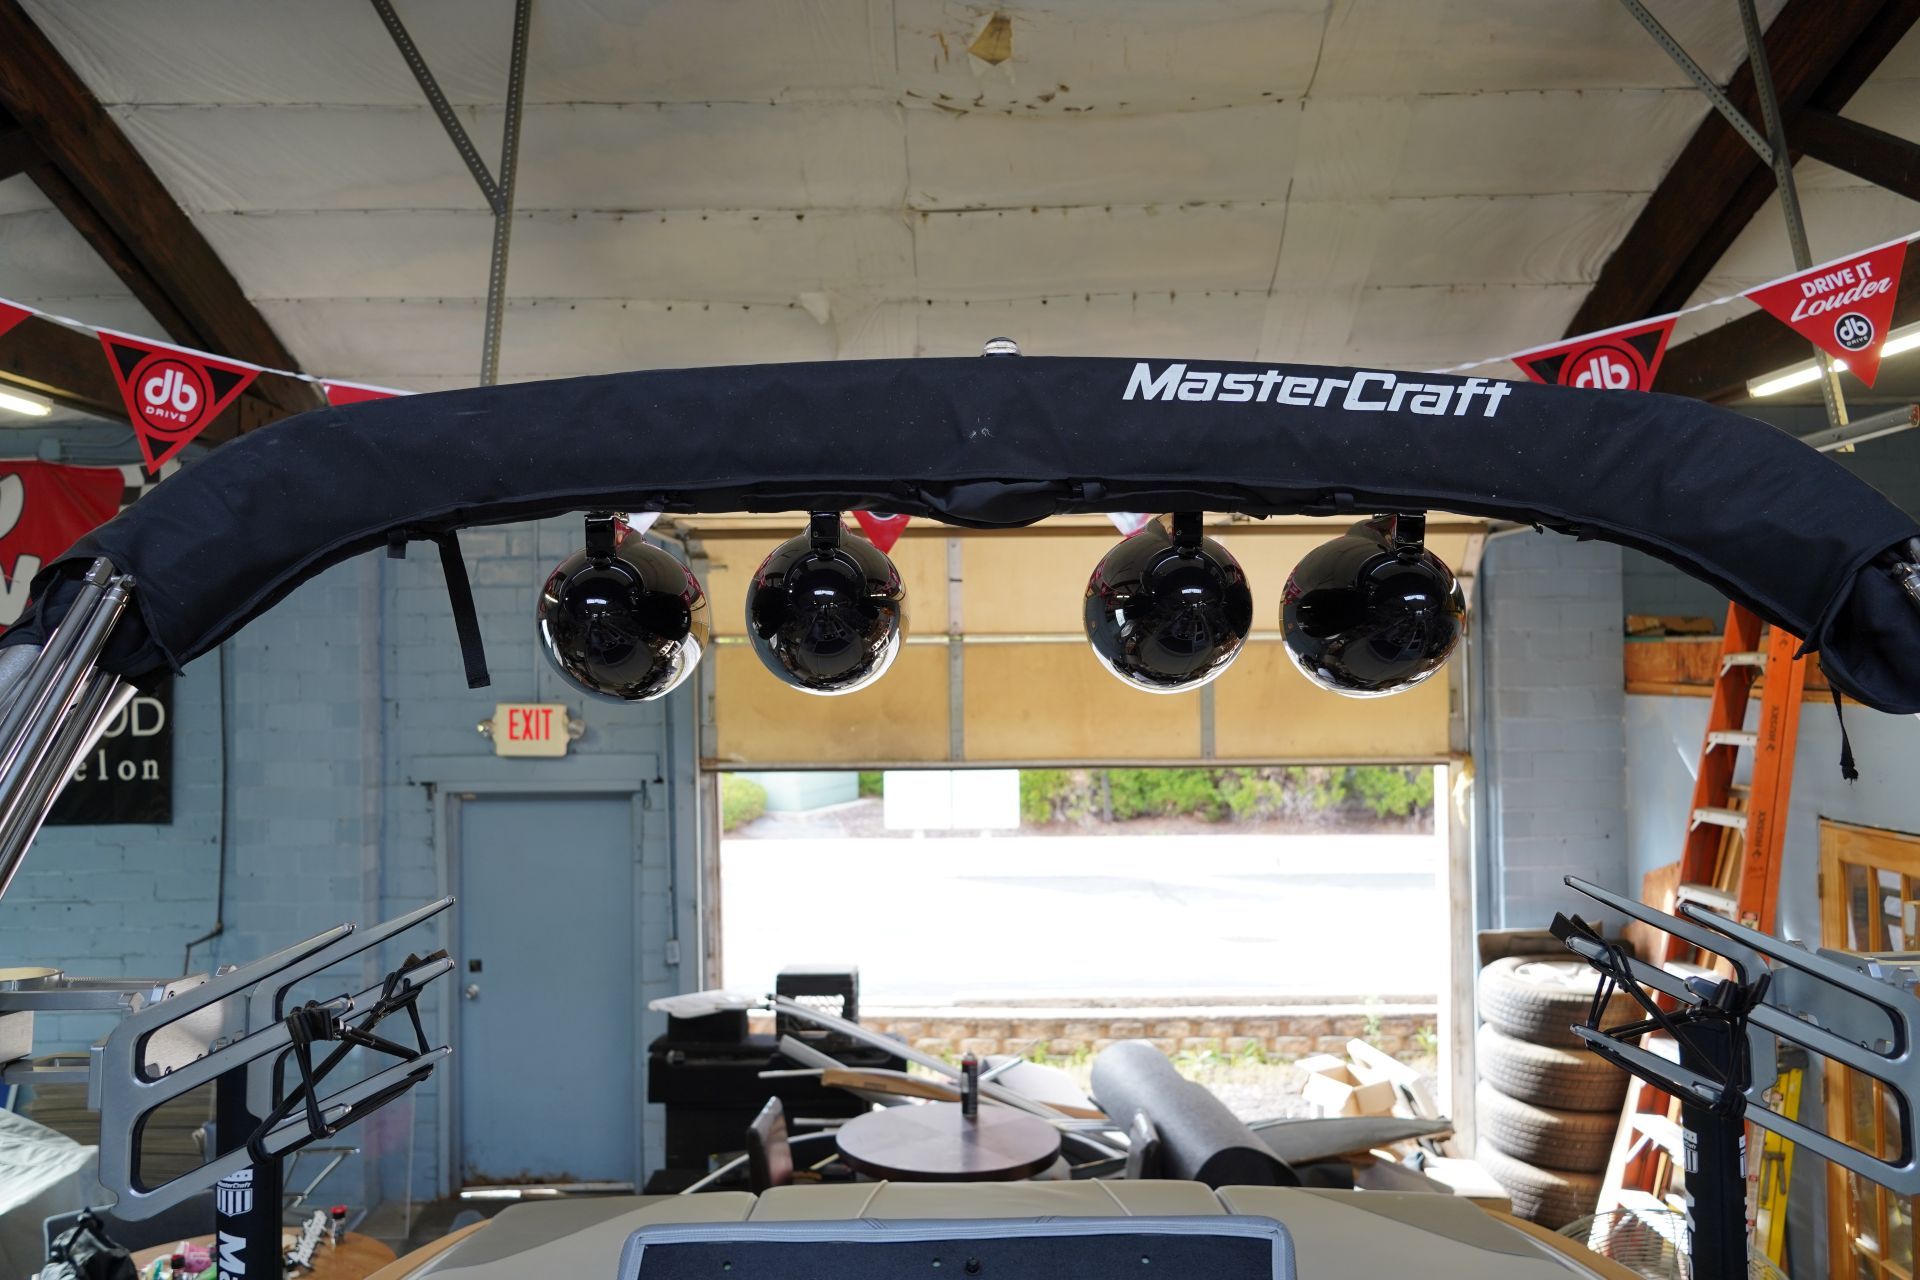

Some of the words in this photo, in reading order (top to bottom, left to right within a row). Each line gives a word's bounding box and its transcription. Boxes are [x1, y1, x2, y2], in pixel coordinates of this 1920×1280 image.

[1801, 268, 1856, 298] DRIVE
[1855, 261, 1873, 280] IT
[1790, 277, 1893, 323] Louder
[1839, 317, 1869, 341] db
[1846, 335, 1869, 347] DRIVE
[144, 368, 197, 412] db
[1122, 362, 1512, 417] MasterCraft
[1575, 354, 1630, 390] db
[145, 405, 187, 423] DRIVE
[508, 708, 554, 741] EXIT
